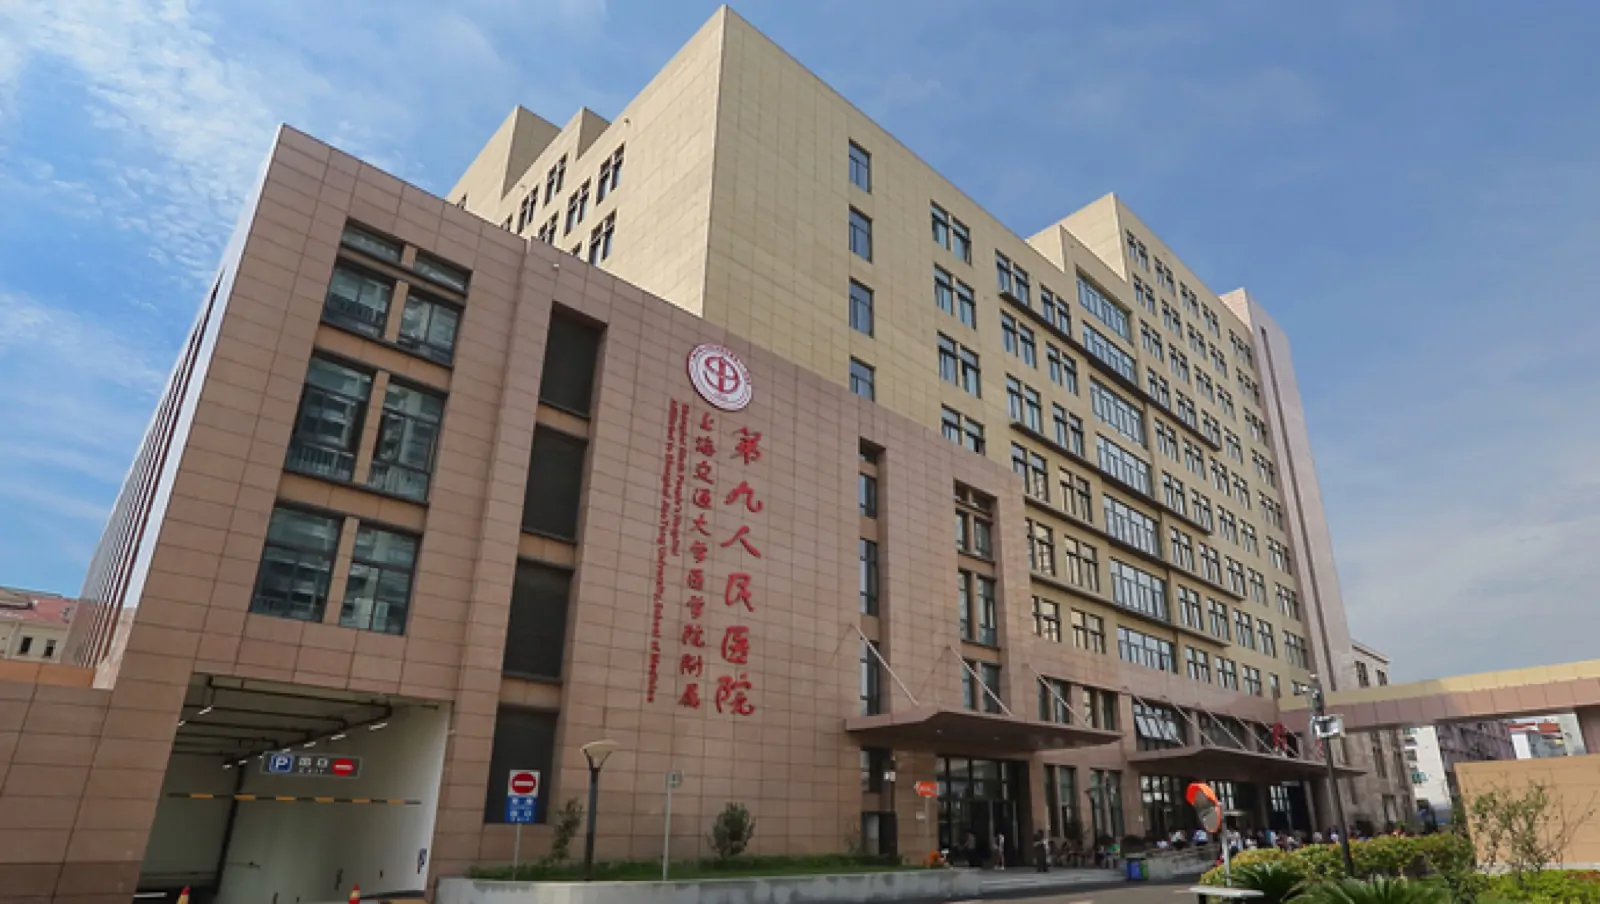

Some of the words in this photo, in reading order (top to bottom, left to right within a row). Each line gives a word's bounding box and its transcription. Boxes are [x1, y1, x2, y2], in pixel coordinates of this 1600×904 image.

[670, 514, 681, 556] Hospital
[716, 426, 763, 715] 第九人民医院
[648, 653, 659, 702] Medicine
[276, 757, 288, 768] P
